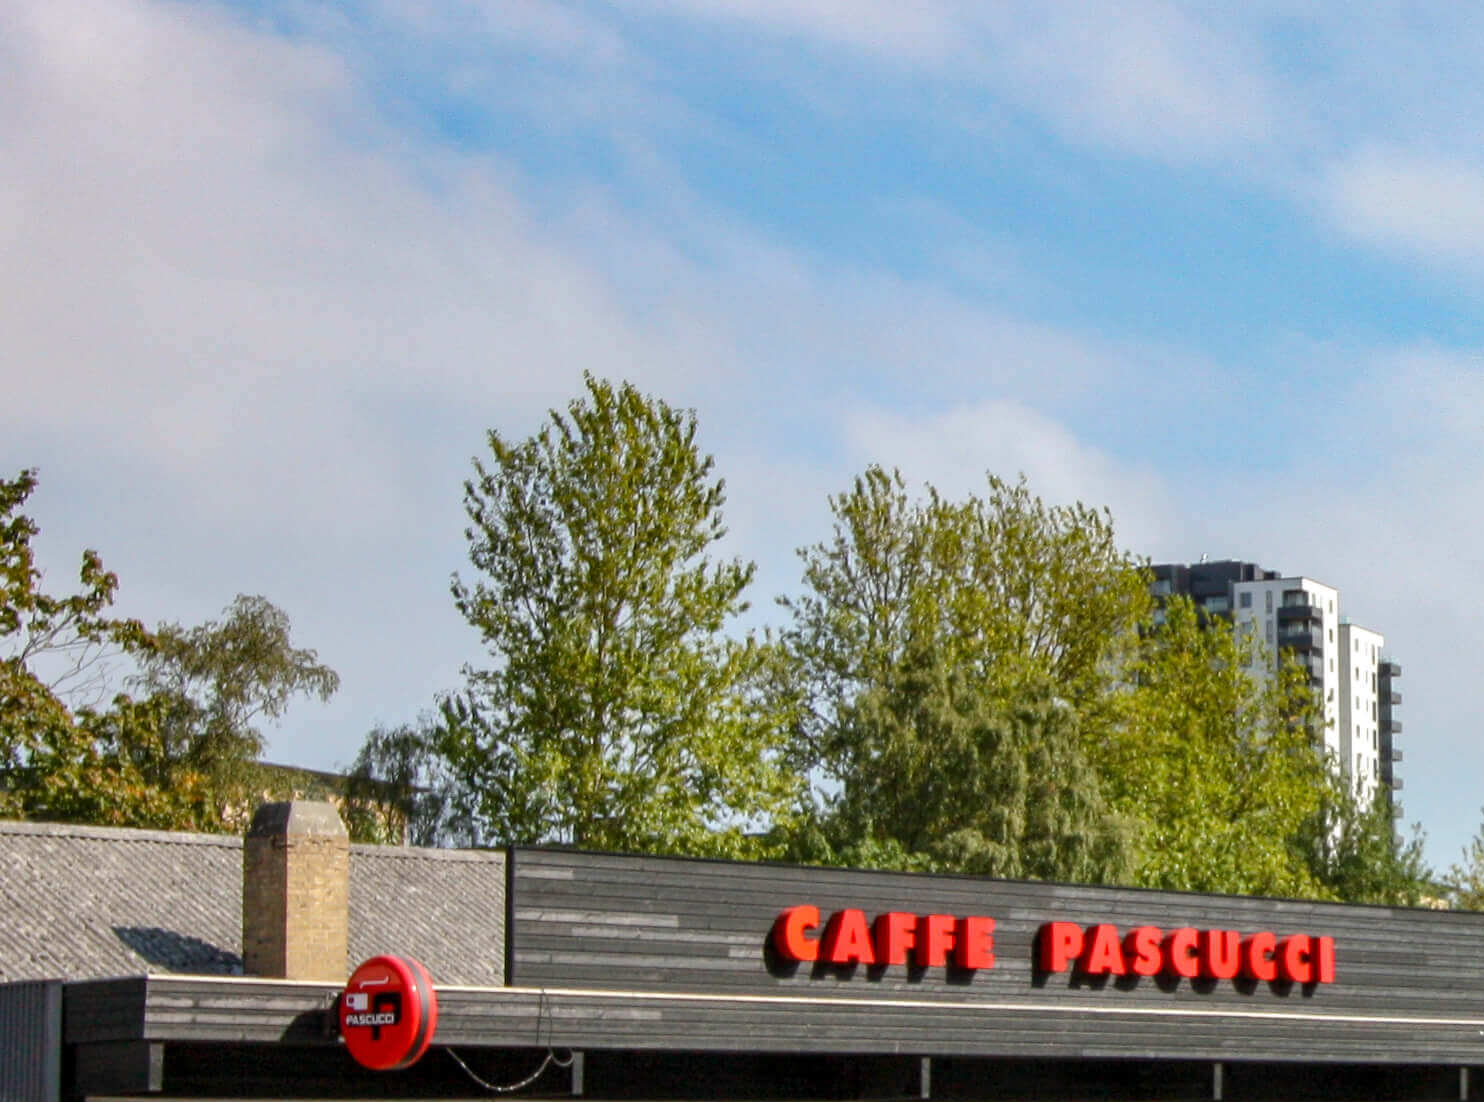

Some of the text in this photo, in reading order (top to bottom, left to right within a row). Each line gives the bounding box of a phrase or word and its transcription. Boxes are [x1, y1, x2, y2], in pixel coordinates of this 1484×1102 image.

[773, 905, 1336, 984] CAFFE PASCUCCI
[345, 1012, 395, 1026] PASCUCCI
